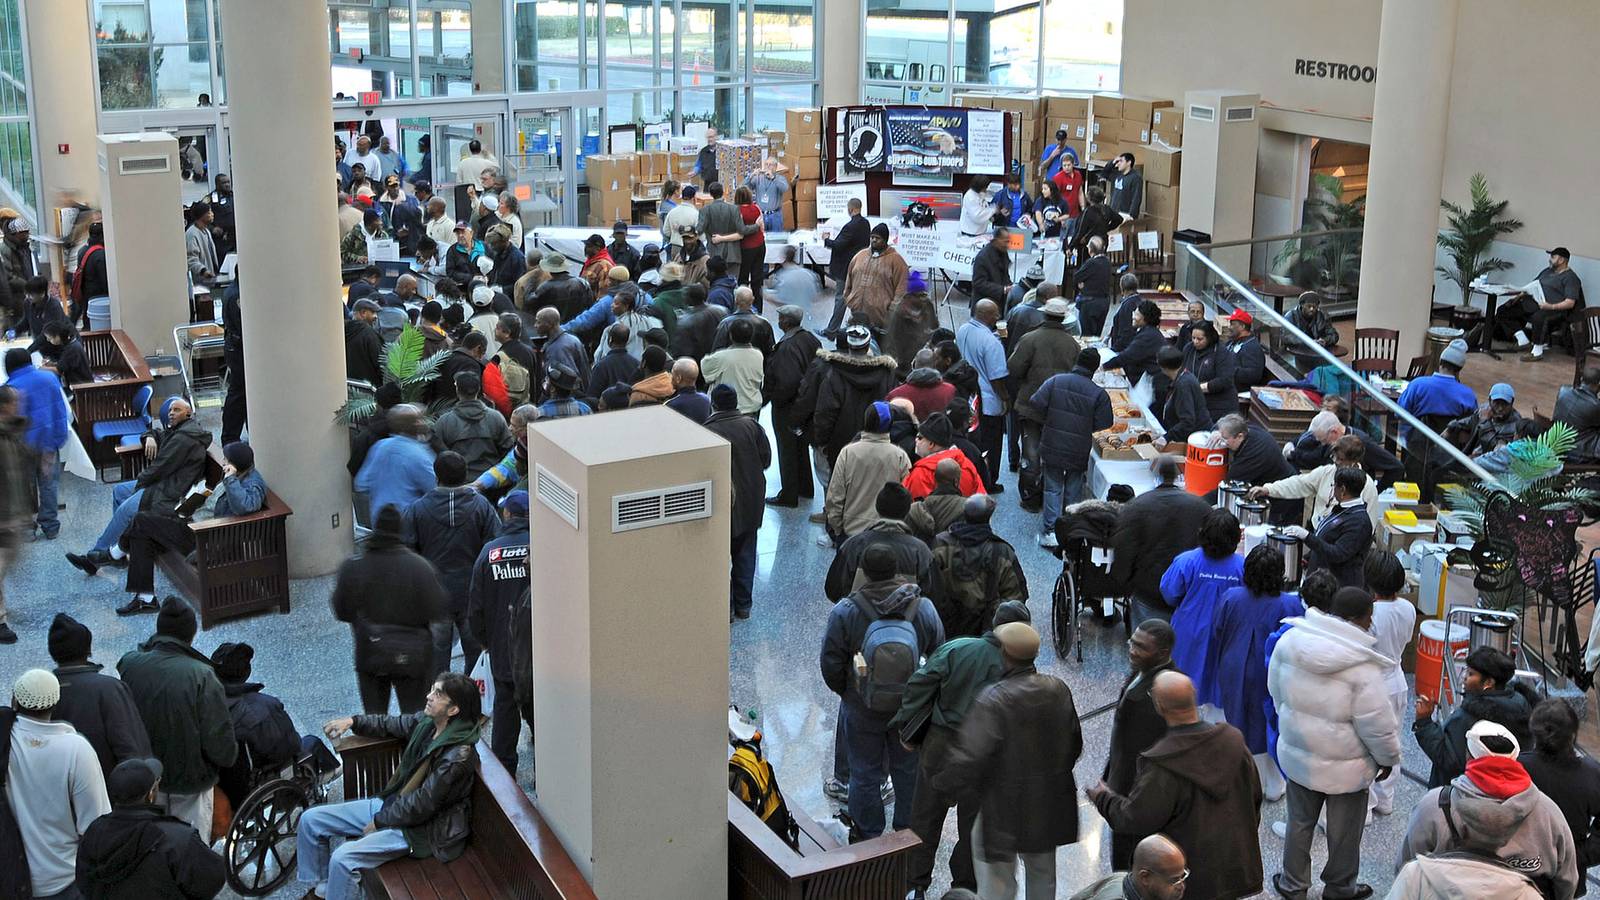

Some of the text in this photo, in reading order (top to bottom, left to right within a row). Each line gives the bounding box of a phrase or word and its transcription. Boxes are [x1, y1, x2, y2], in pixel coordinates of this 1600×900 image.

[1295, 58, 1377, 83] RESTROO
[363, 92, 379, 106] EXIT
[928, 115, 962, 128] APWU
[887, 154, 923, 166] SUPPORTS
[938, 155, 964, 167] TROOPS
